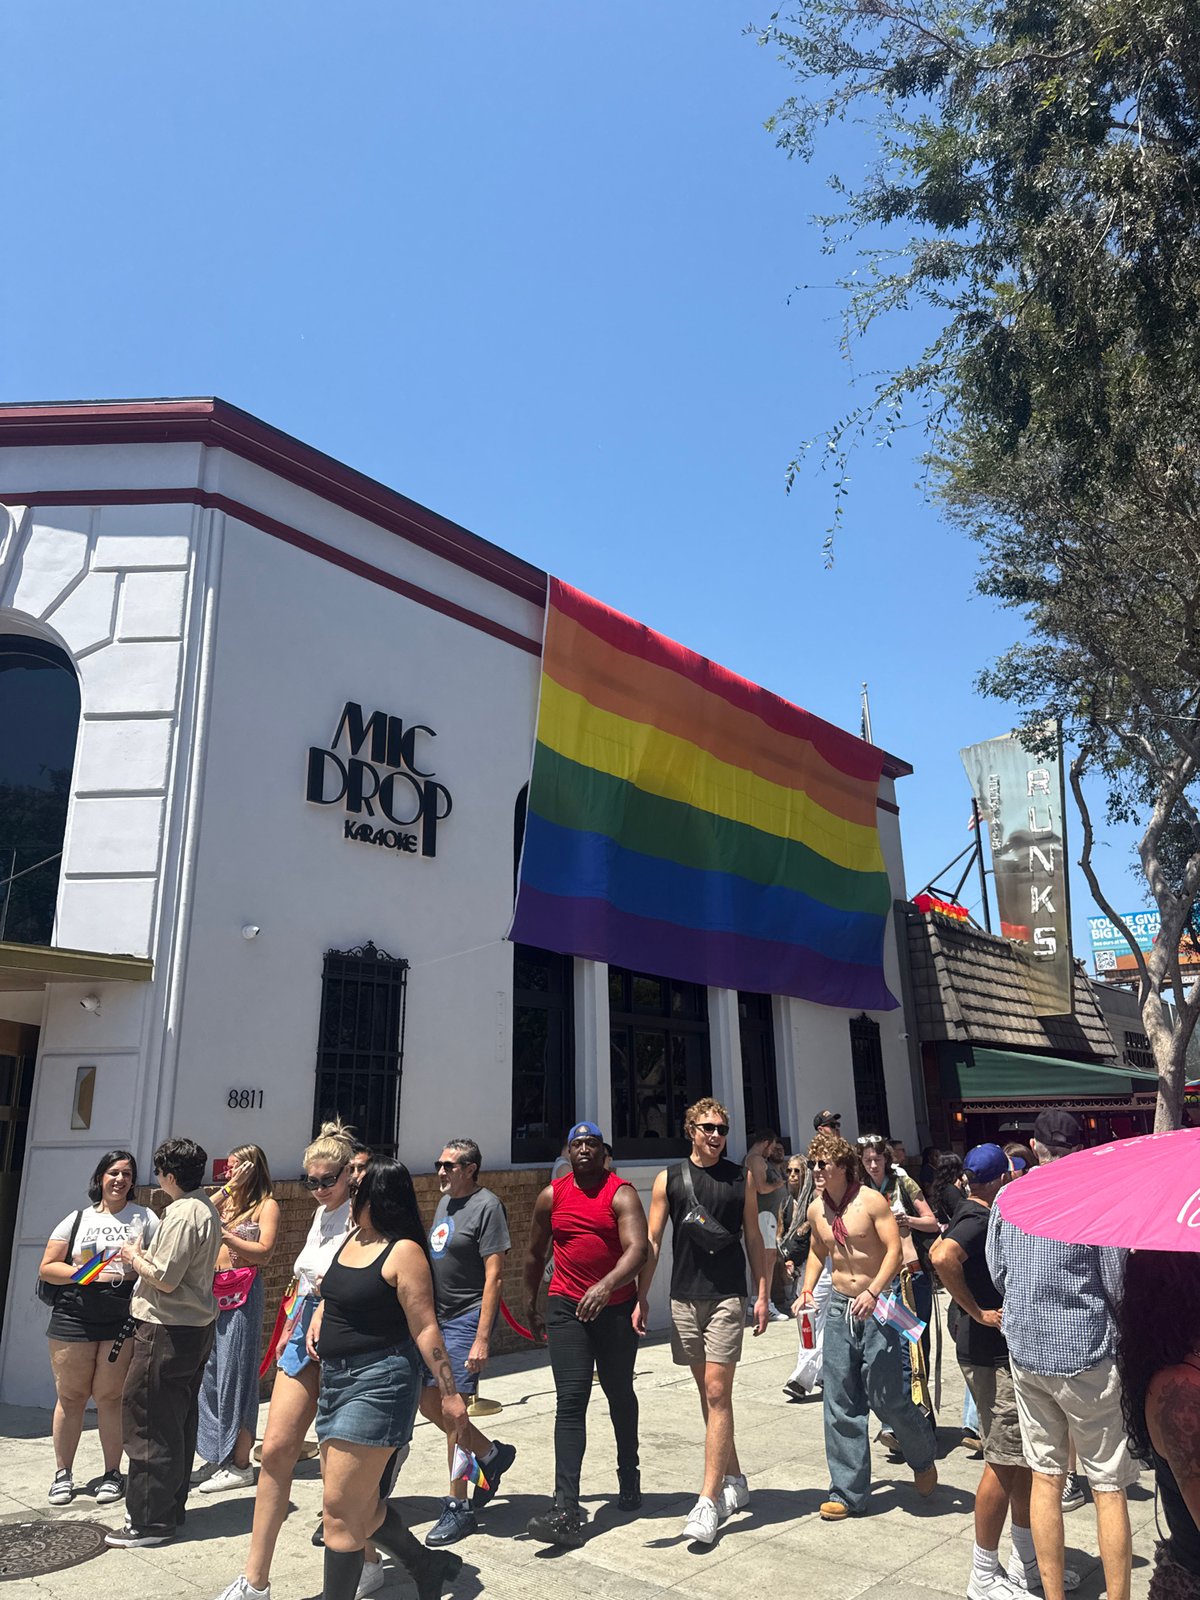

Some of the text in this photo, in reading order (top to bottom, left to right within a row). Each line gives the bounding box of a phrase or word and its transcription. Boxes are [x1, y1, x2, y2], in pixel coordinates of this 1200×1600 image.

[331, 701, 437, 778] MIC
[306, 746, 453, 858] DROP
[344, 819, 418, 853] KARAOKE
[1027, 731, 1058, 957] RUNKS
[1091, 928, 1112, 940] BIG
[1114, 924, 1147, 938] DCK
[227, 1089, 263, 1109] 8811
[86, 1225, 131, 1236] MOVE
[105, 1234, 130, 1242] GA
